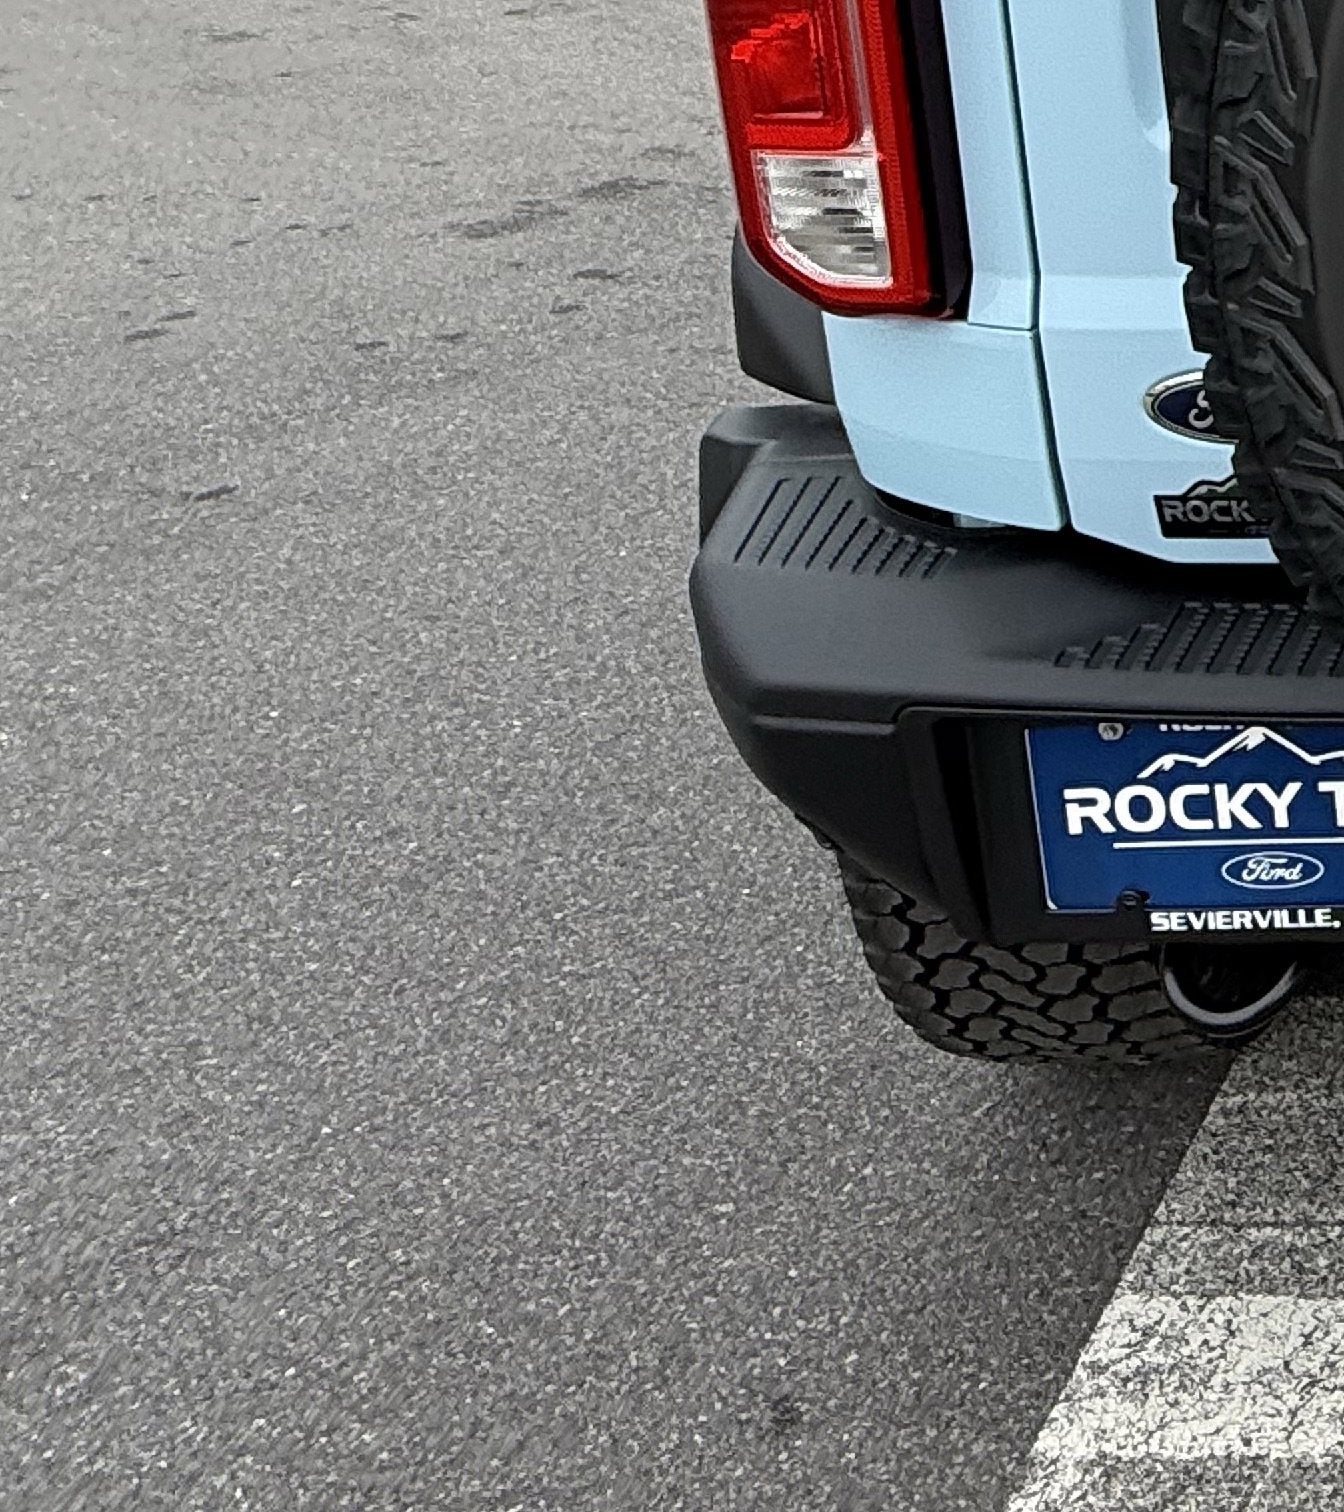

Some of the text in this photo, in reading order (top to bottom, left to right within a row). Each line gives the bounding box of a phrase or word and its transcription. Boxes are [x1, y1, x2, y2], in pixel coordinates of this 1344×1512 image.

[1161, 500, 1269, 523] ROCK
[1062, 780, 1302, 836] ROCKY
[1241, 854, 1304, 884] Ford
